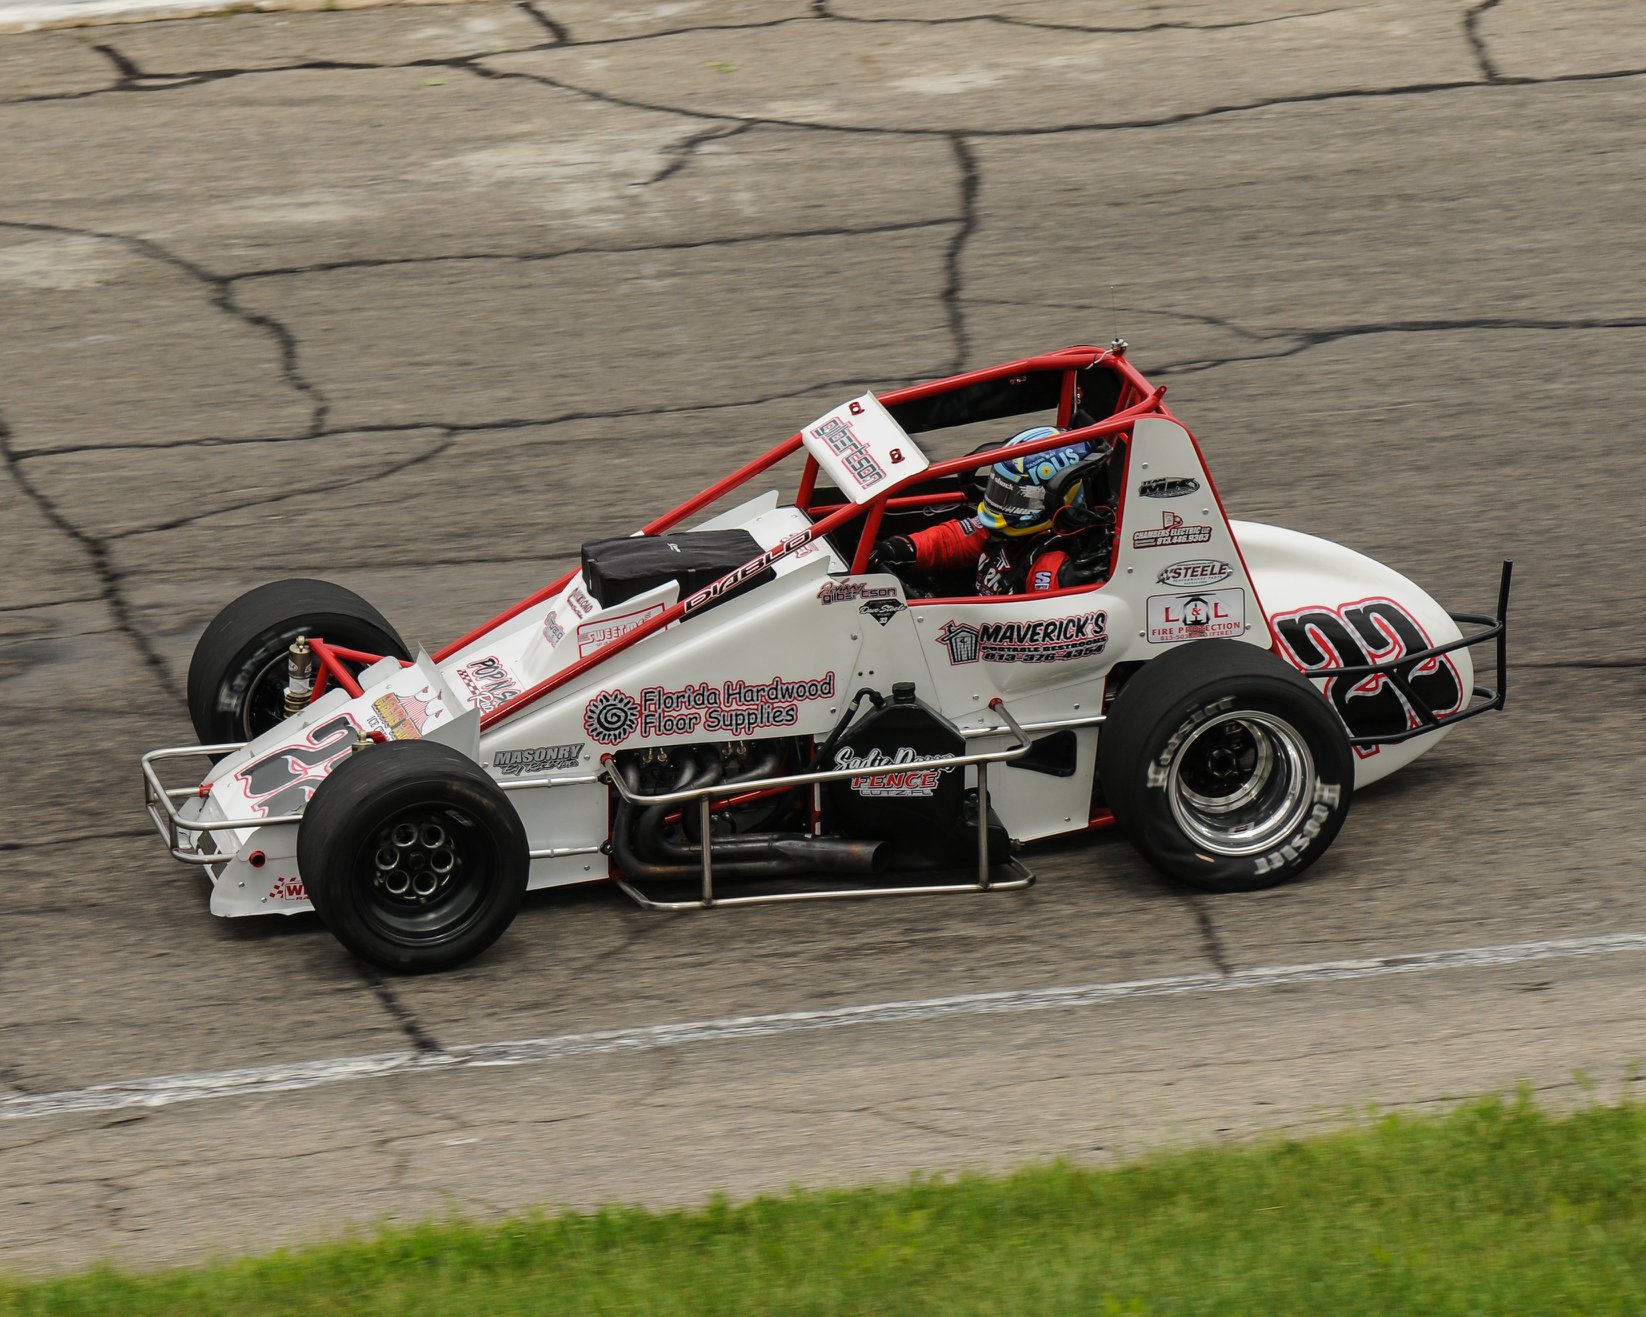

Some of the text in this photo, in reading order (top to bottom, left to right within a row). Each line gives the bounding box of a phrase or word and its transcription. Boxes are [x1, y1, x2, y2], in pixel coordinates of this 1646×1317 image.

[1134, 529, 1170, 541] CHAMBERS
[1170, 526, 1200, 537] ELECTRIC
[684, 530, 811, 613] DIABLO
[1170, 563, 1228, 580] STEELE
[1165, 602, 1228, 623] L & L
[979, 612, 1107, 645] MAVERICK'S
[1152, 621, 1241, 636] FIRE PROTECTION
[981, 636, 1107, 654] PORTABLE RESTROOMS
[467, 656, 505, 681] POP
[641, 674, 835, 713] Florida Hardwood
[641, 704, 797, 736] Floor Supplies
[494, 743, 585, 767] MASONRY
[852, 772, 939, 789] FENCE
